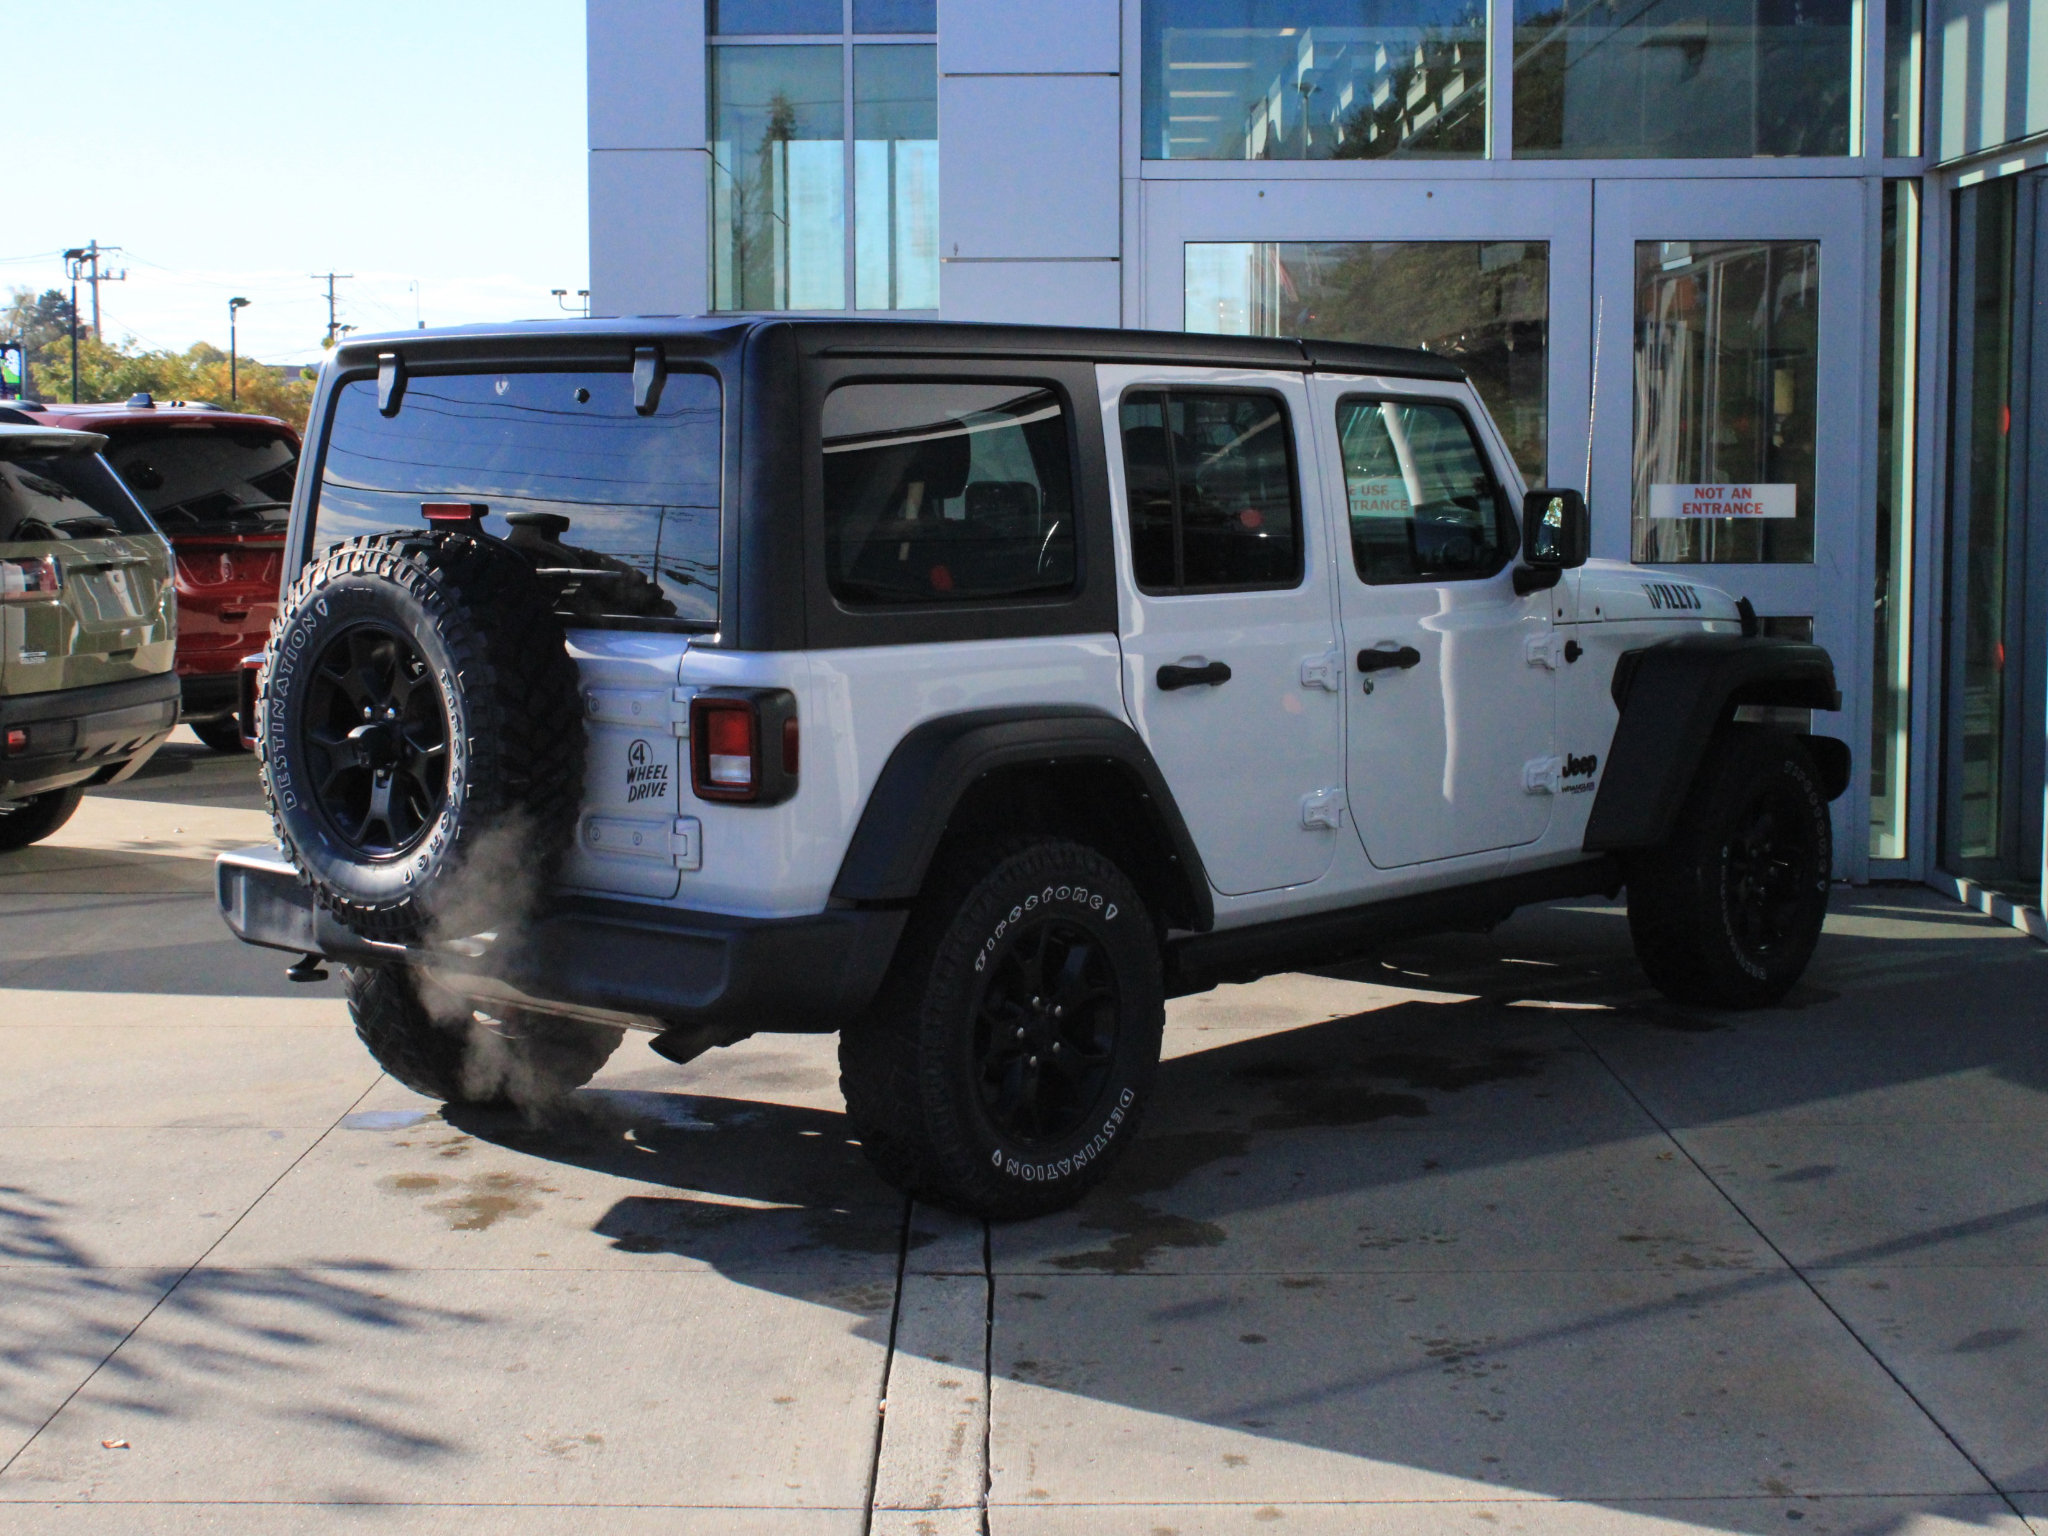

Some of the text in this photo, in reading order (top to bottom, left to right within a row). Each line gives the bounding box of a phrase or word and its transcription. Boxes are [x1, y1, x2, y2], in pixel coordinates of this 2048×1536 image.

[1361, 484, 1388, 496] USE
[1694, 487, 1753, 499] NOT AN
[1351, 499, 1409, 511] TRANCE
[1681, 502, 1764, 515] ENTRANCE
[1641, 583, 1702, 610] WILLYS
[271, 610, 318, 813] DESTINATION
[632, 743, 646, 765] 4
[626, 764, 669, 785] WHEEL
[1562, 752, 1598, 779] Jeep
[627, 781, 668, 804] DRIVE
[1005, 1086, 1136, 1182] DESTINATION
